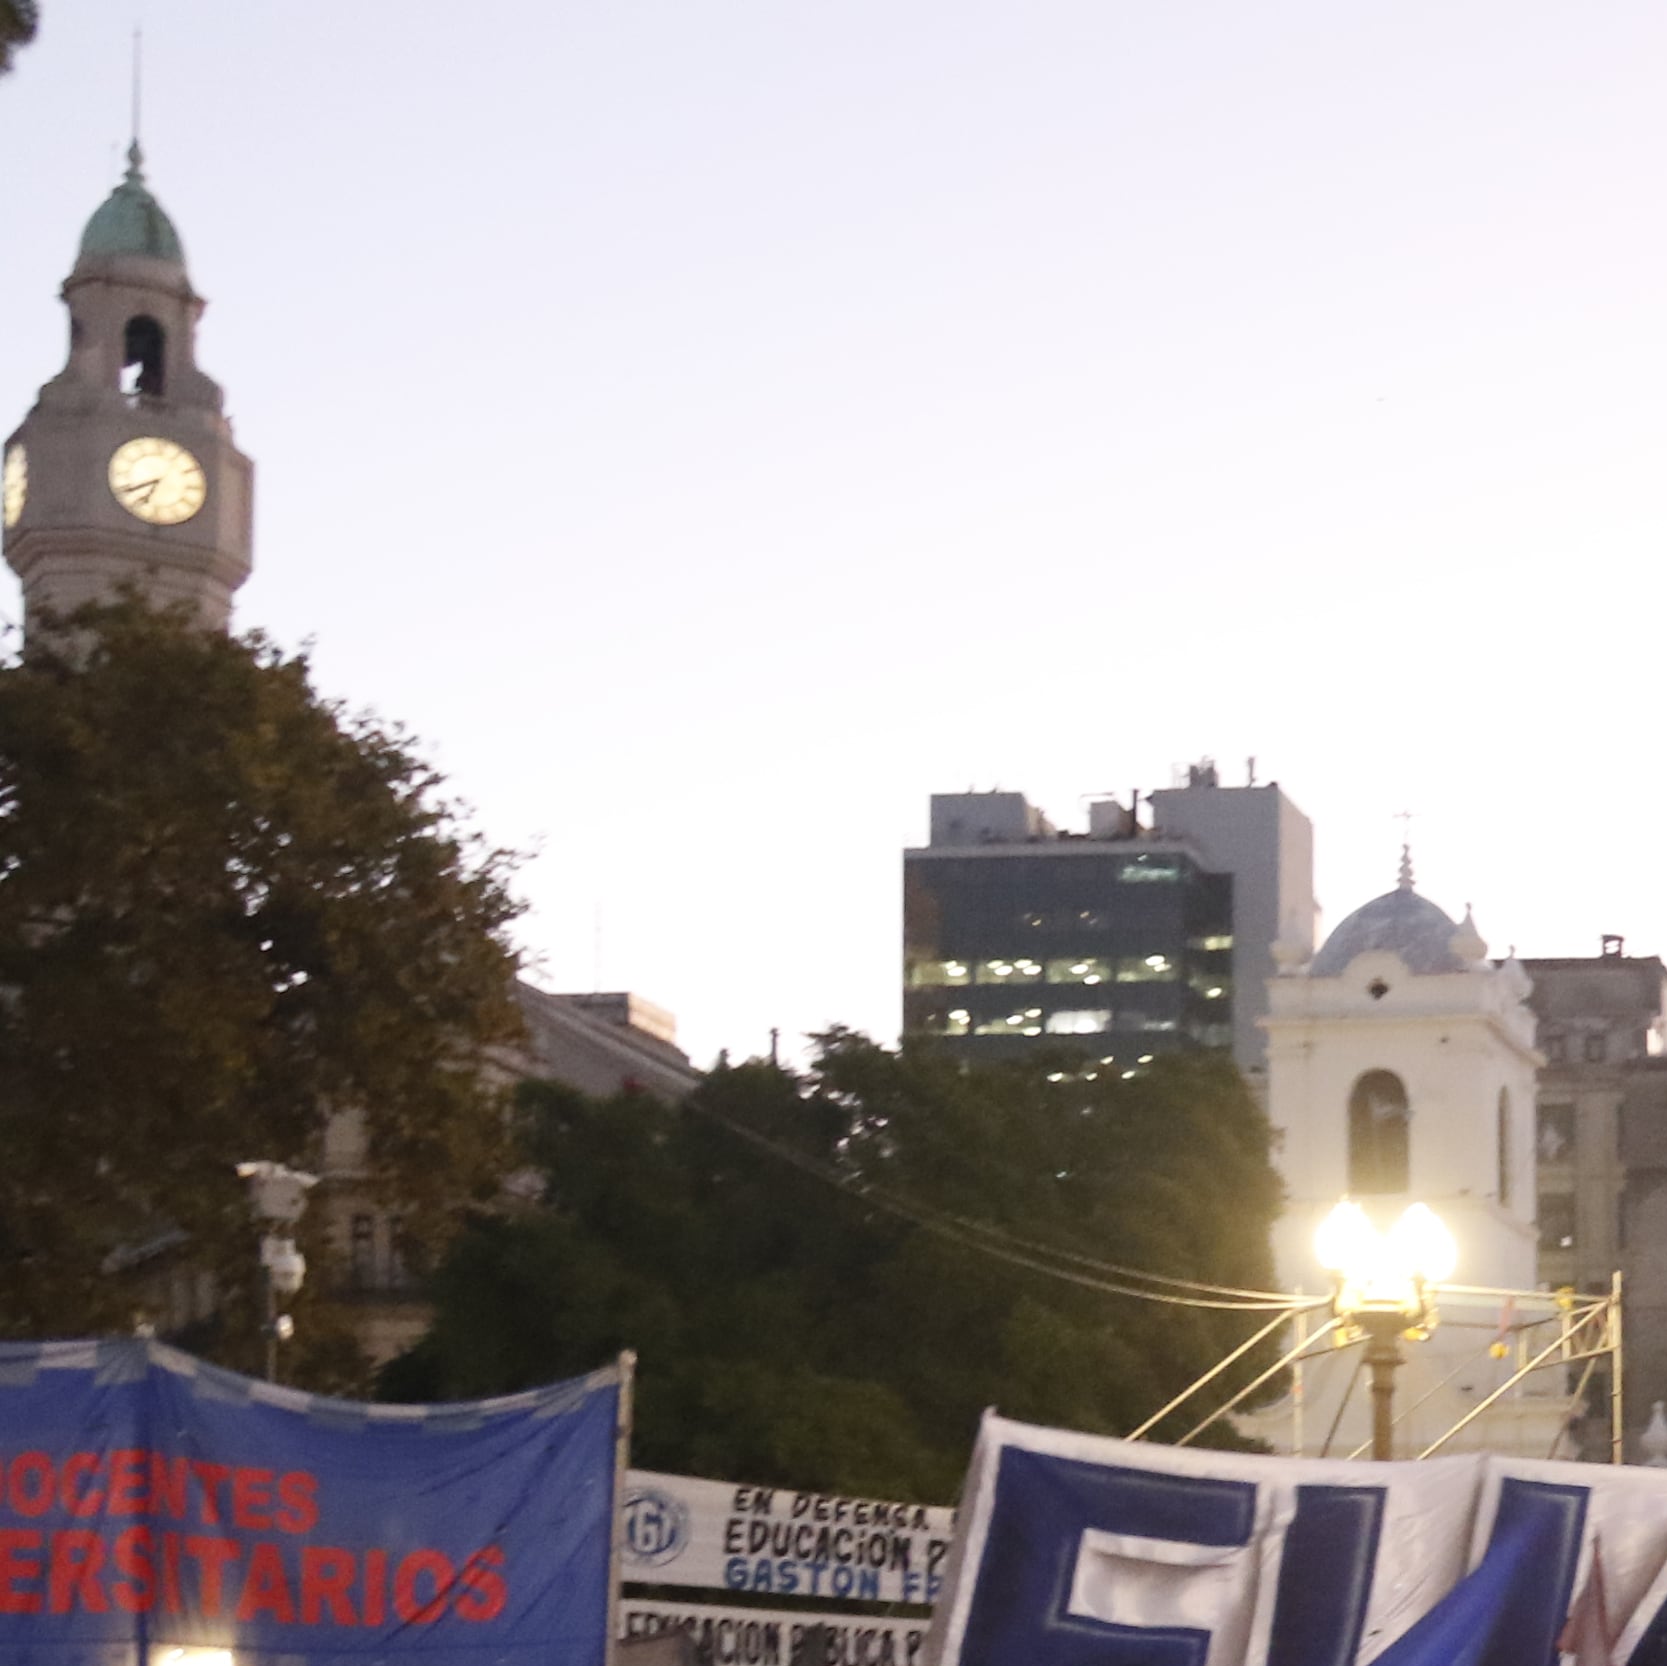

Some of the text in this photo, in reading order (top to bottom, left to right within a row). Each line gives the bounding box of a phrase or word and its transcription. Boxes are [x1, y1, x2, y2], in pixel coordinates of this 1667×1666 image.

[733, 1487, 930, 1531] EN DEFENSA
[725, 1556, 882, 1600] GASTON
